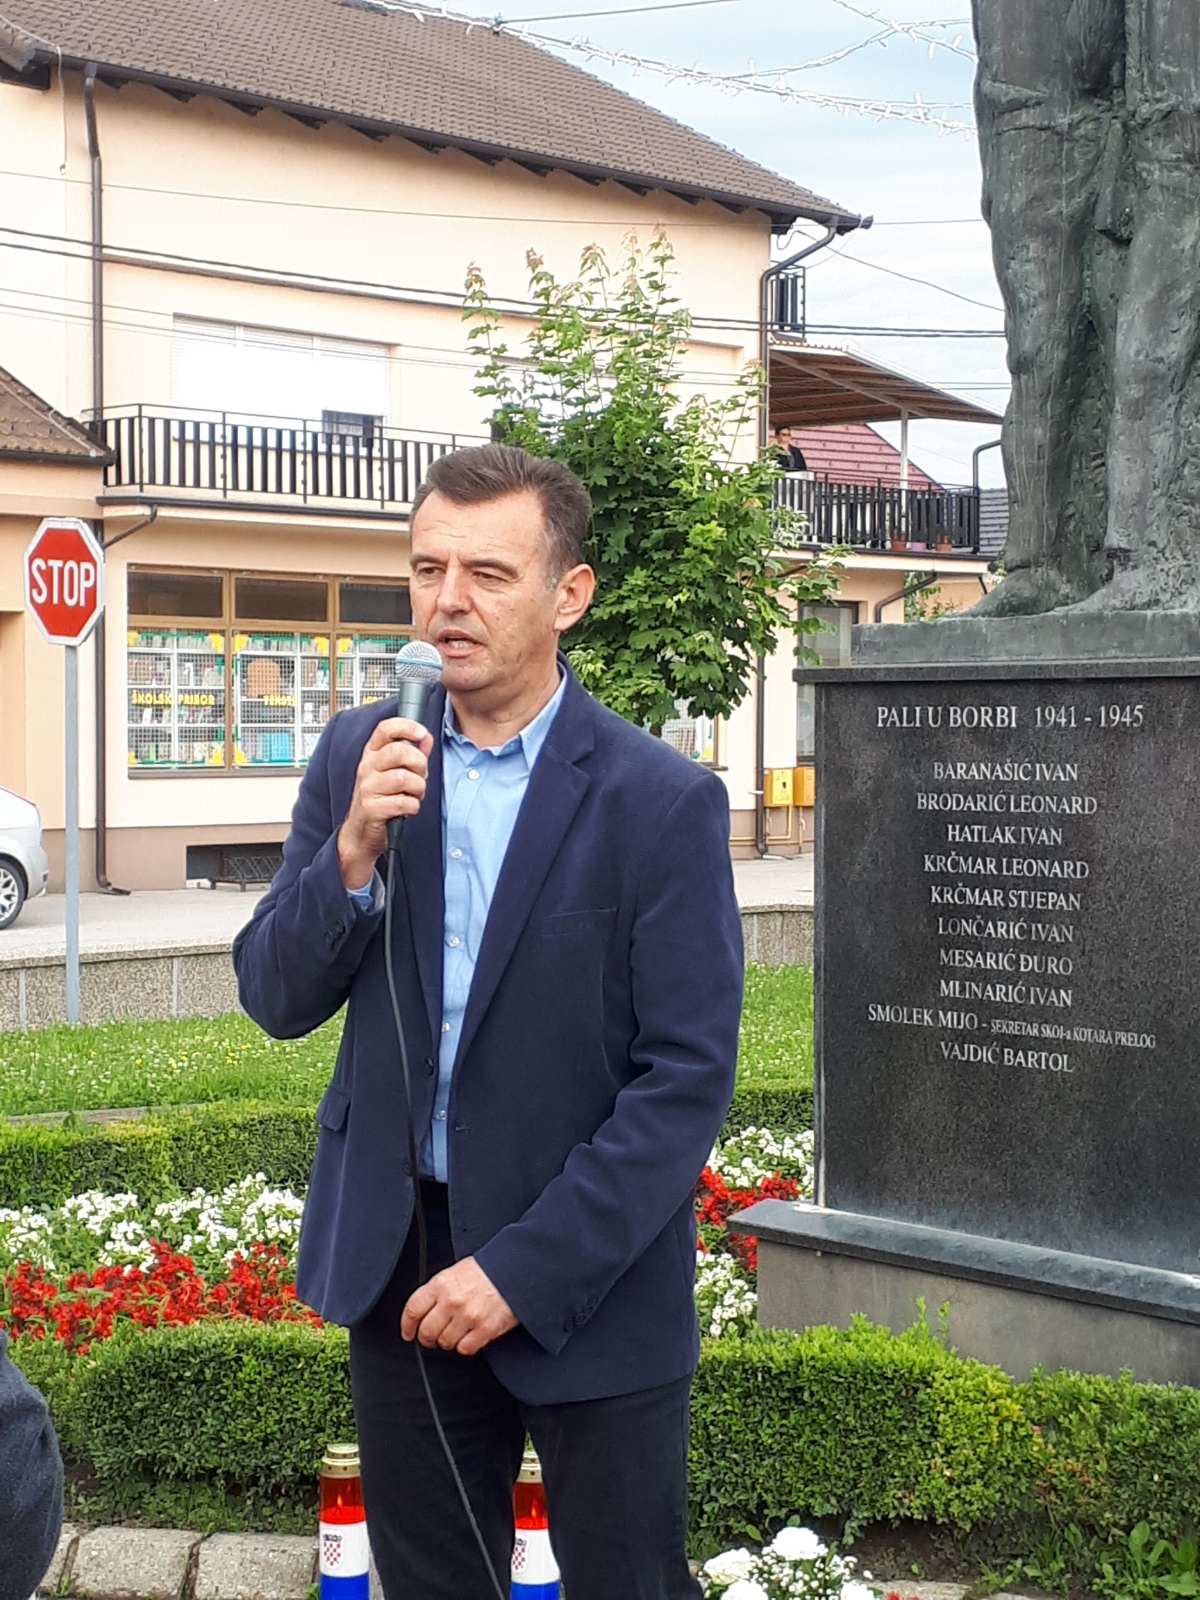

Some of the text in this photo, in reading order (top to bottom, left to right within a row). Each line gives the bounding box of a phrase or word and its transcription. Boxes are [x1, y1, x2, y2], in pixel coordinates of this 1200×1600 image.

[31, 558, 95, 607] STOP
[877, 705, 921, 728] PALI
[928, 706, 942, 728] U
[950, 706, 1017, 728] BORBI
[1034, 705, 1077, 728] 1941
[1098, 704, 1144, 728] 1945
[933, 757, 1078, 782] BARANAŠIĆ IVAN
[917, 790, 1098, 814] BRODARIĆ LEONARD
[948, 824, 1062, 846] HATLAK IVAN
[923, 851, 1089, 879] KRČMAR LEONARD
[930, 882, 1081, 911] KRČMAR STJEPAN
[938, 914, 1073, 943] LONČARIĆ IVAN
[939, 947, 1073, 976] MESARIĆ ĐURO
[939, 980, 1073, 1008] MLINARIĆ IVAN
[868, 1003, 934, 1027] SMOLEK
[938, 1009, 978, 1031] MIJO
[991, 1019, 1039, 1037] SEKRETAR
[1073, 1027, 1113, 1044] KOTARA
[1115, 1031, 1156, 1049] PRELOG
[940, 1041, 1074, 1073] VAJDIĆ BARTOL
